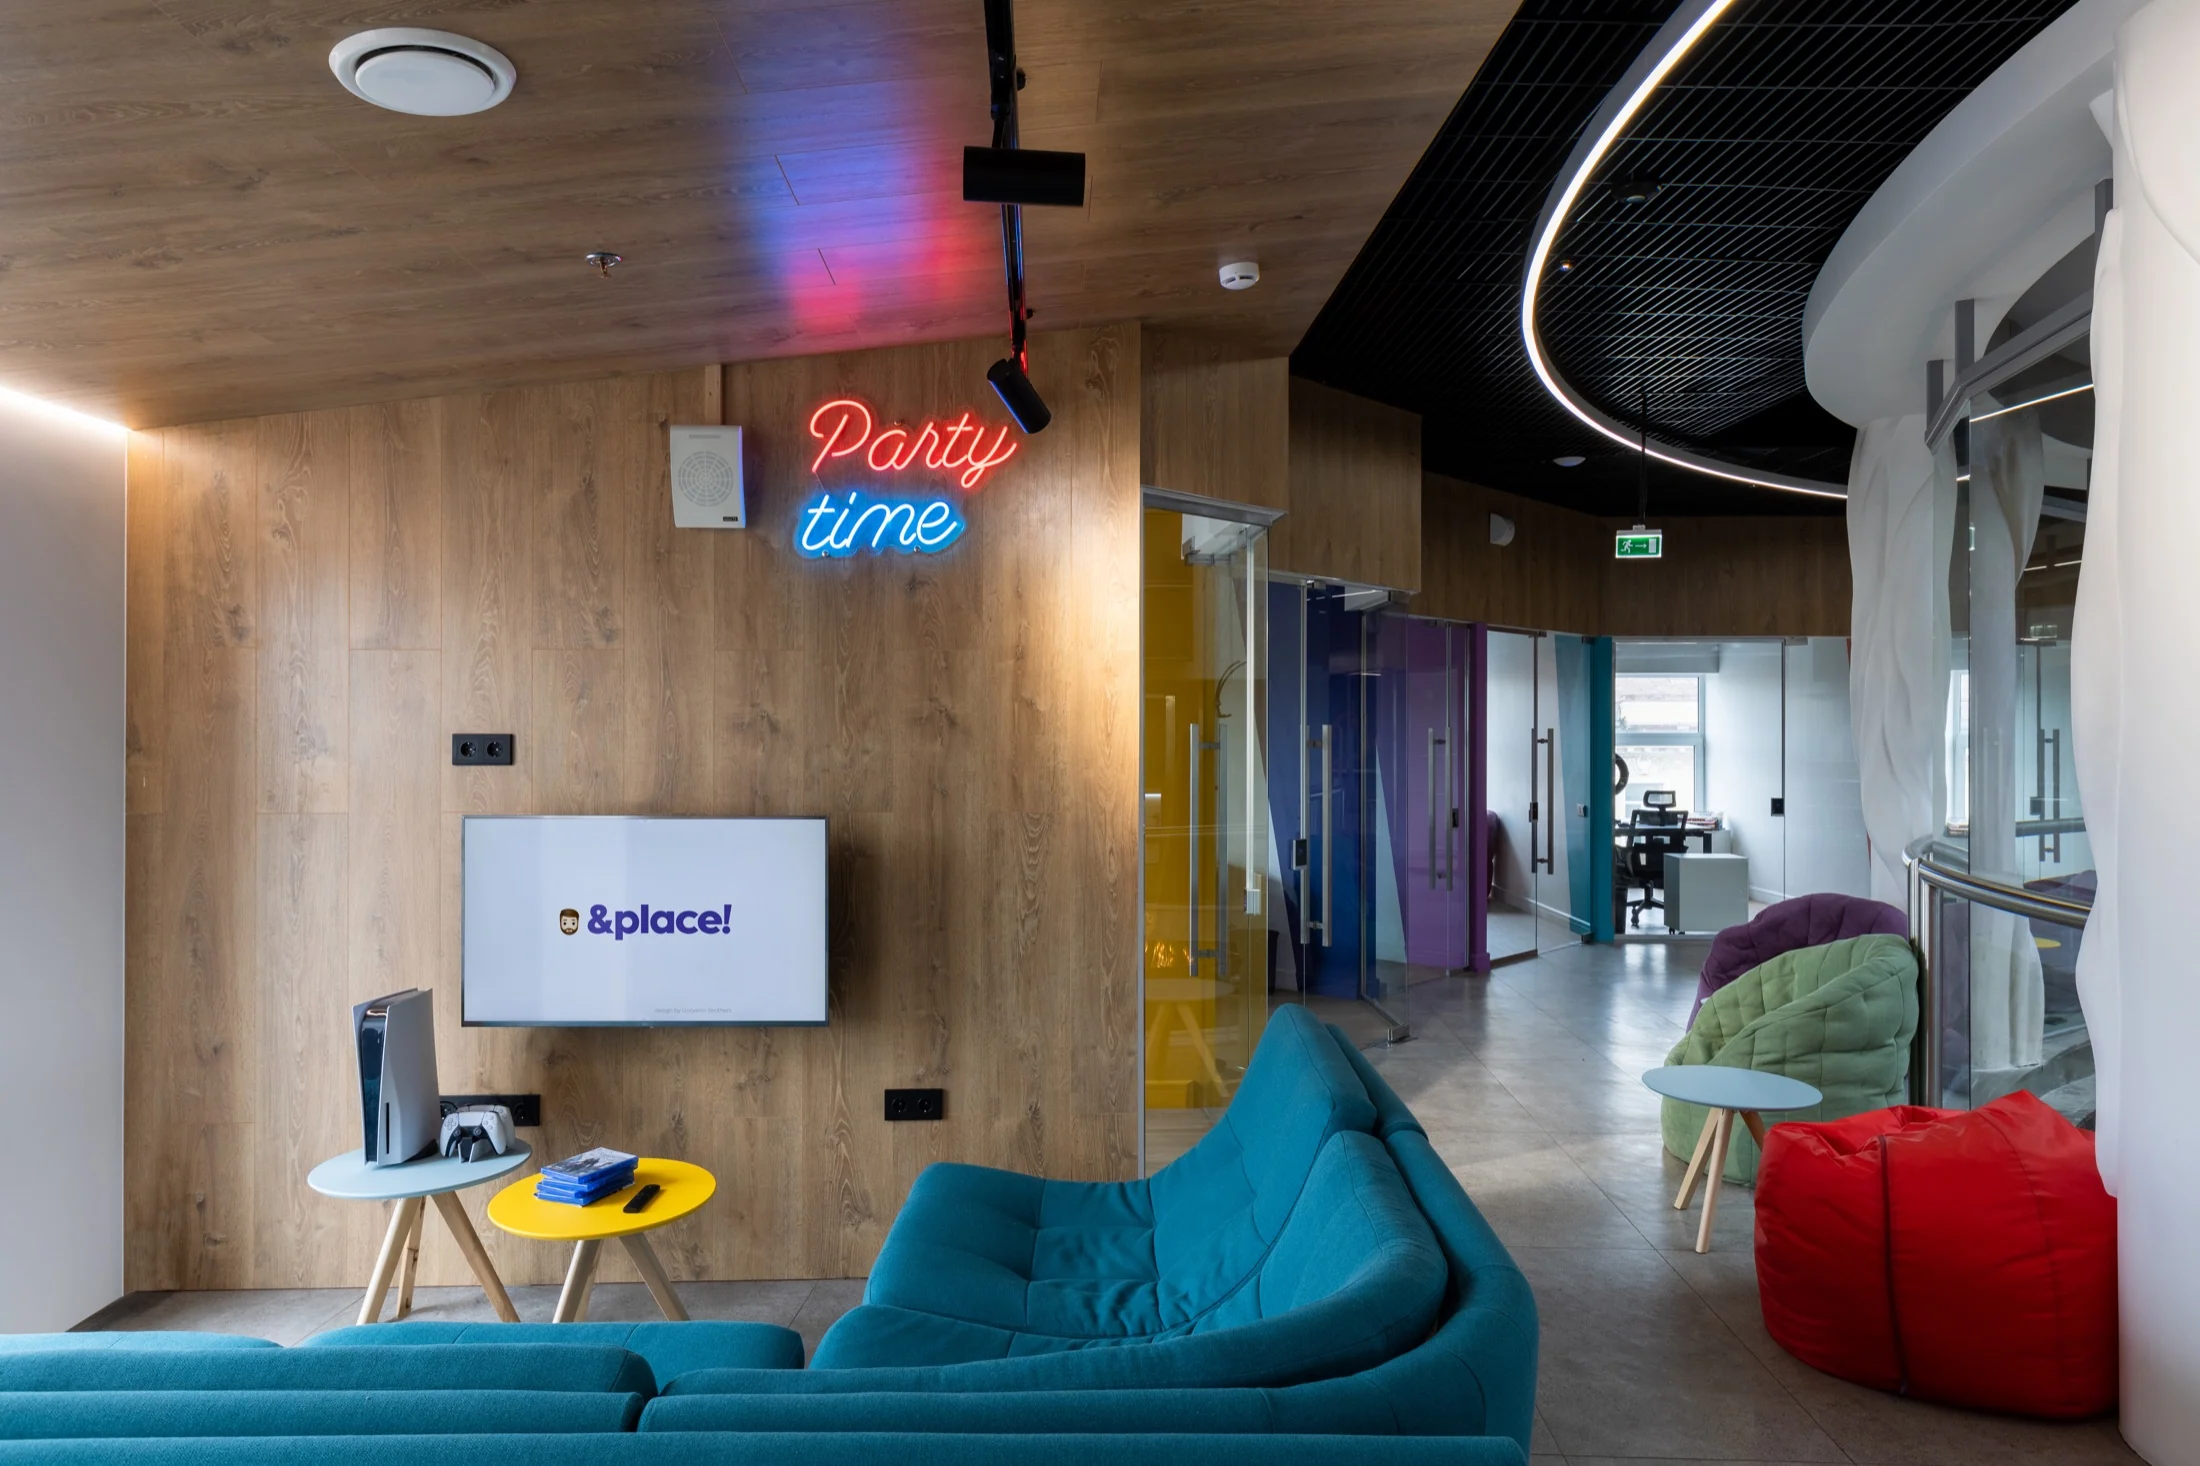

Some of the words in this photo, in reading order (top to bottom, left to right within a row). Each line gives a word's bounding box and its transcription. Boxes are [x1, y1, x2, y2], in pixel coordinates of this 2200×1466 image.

[810, 400, 1017, 488] Party
[802, 492, 957, 550] time
[587, 904, 732, 940] &place!
